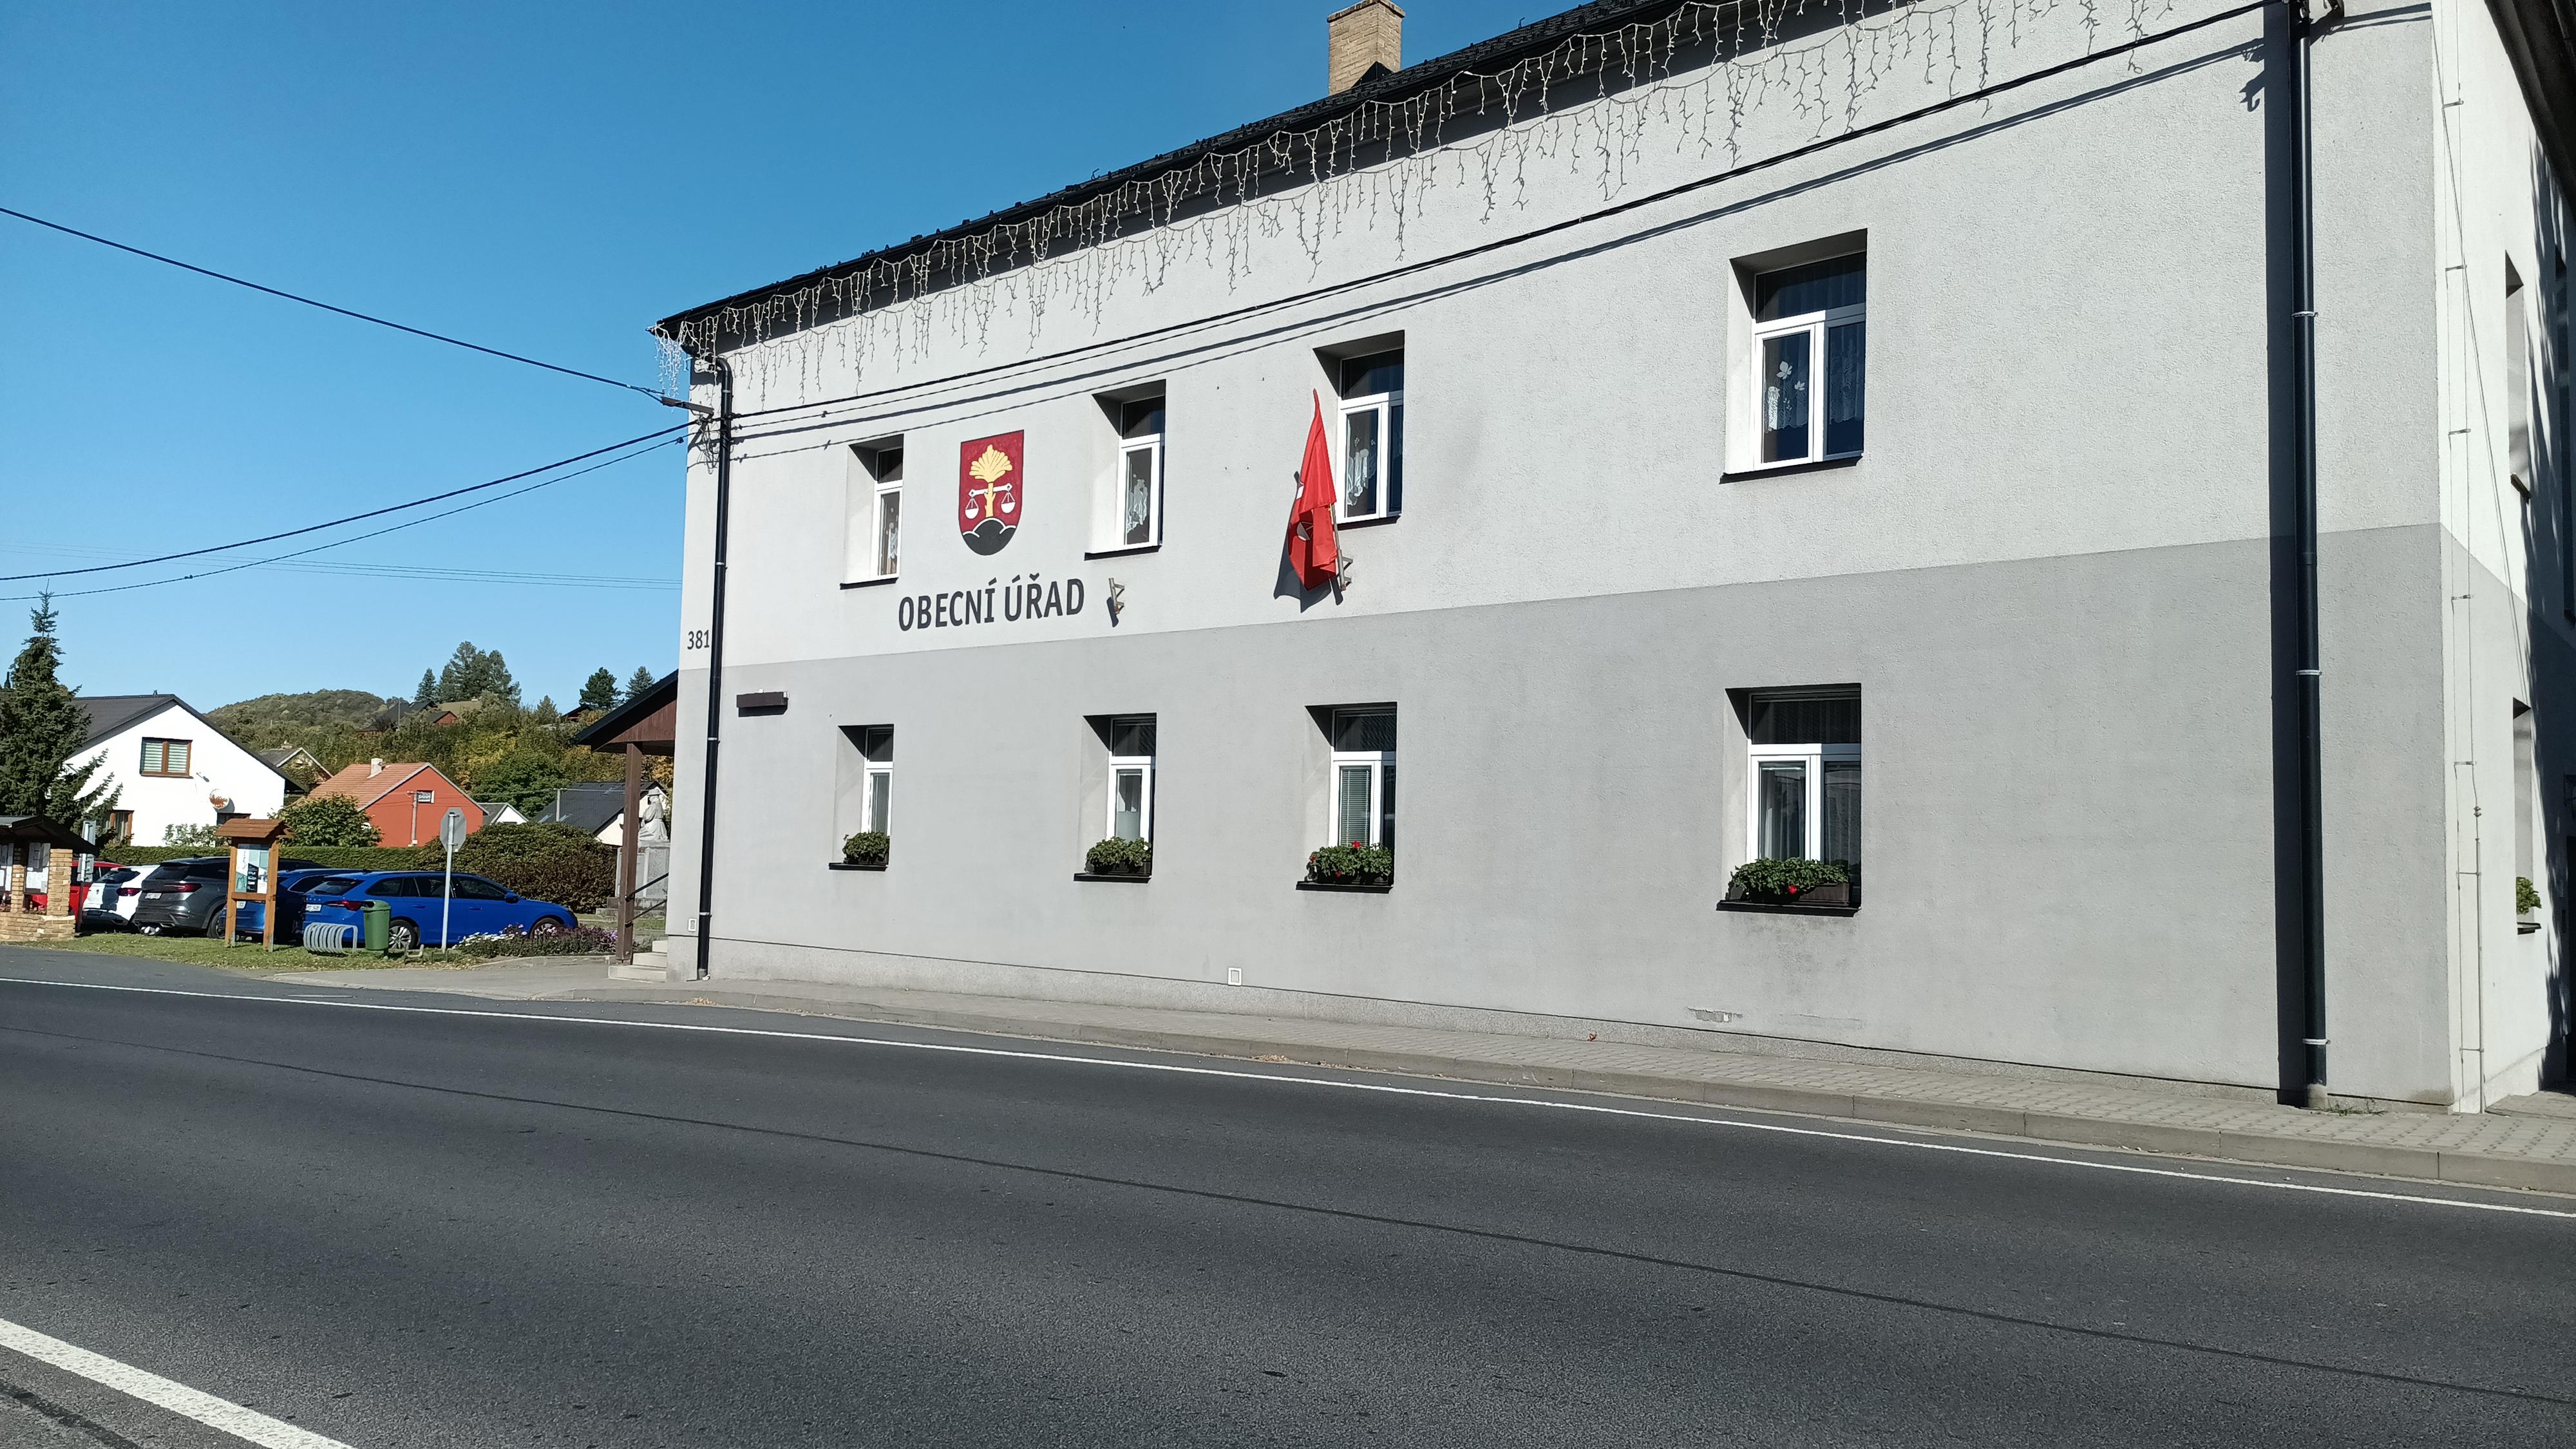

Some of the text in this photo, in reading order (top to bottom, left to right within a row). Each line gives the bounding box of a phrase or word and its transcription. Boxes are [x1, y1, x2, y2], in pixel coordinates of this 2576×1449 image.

[898, 573, 1084, 631] OBECNÍ ÚŘAD
[687, 629, 710, 650] 381
